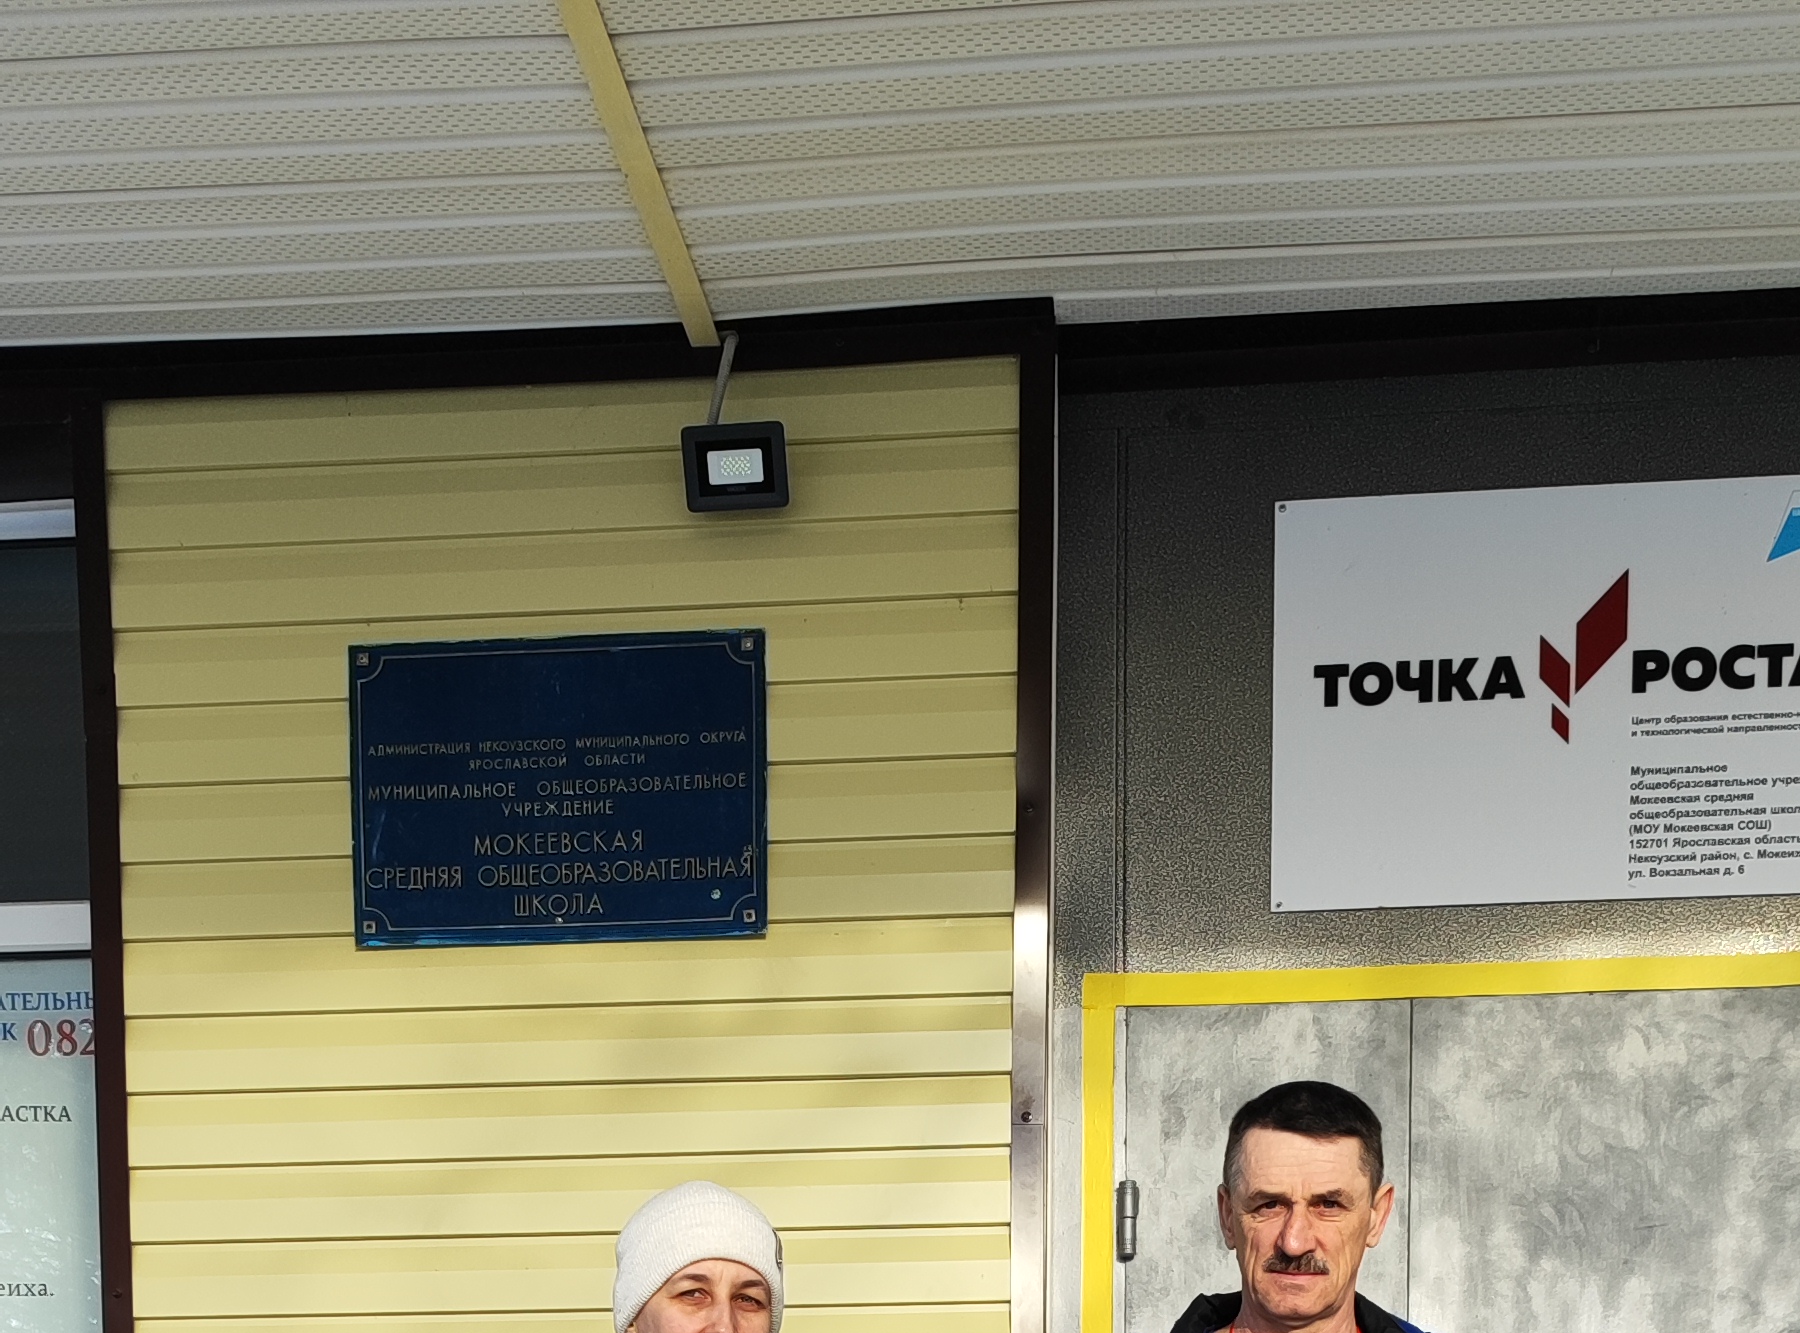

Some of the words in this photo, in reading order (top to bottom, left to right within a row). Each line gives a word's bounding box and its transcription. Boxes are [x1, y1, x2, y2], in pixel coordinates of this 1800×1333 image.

[1313, 655, 1526, 708] ТОЧКА
[1631, 643, 1800, 694] РОСТ
[1631, 716, 1662, 727] Центр
[1664, 713, 1729, 725] образования
[1640, 724, 1725, 737] технологической
[368, 742, 471, 757] АДМИНИСТРАЦИЯ
[478, 738, 567, 754] НЕКОУЗСКОГО
[576, 733, 690, 749] МУНИЦИПАЛЬНОГО
[700, 730, 747, 744] ОКРУГА
[469, 753, 567, 772] ЯРОСЛАВСКОЙ
[584, 753, 646, 767] ОБЛАСТИ
[1630, 764, 1729, 779] Муниципальное
[368, 782, 517, 801] МУНИЦИПАЛЬНОЕ
[537, 772, 748, 796] ОБЩЕОБРАЗОВАТЕЛЬНОЕ
[1630, 777, 1768, 792] общеобразовательное
[1630, 794, 1701, 806] Мокеевская
[1704, 792, 1754, 804] средняя
[501, 799, 614, 818] УЧРЕЖДЕНИЕ
[1629, 806, 1767, 820] общеобразовательная
[1629, 824, 1660, 837] (МОУ
[1663, 822, 1734, 834] Мокеевская
[1738, 820, 1772, 832] СОШ)
[474, 830, 644, 857] МОКЕЕВСКАЯ
[1629, 838, 1668, 849] 152701
[1672, 837, 1751, 848] Ярославская
[1628, 851, 1697, 865] Некоузский
[1700, 850, 1740, 864] район,
[1743, 851, 1754, 860] с.
[366, 866, 463, 891] СРЕДНЯЯ
[477, 854, 752, 888] ОБЩЕОБРАЗОВАТЕЛЬНАЯ
[1628, 869, 1646, 881] ул.
[1649, 865, 1720, 878] Вокзальная
[1723, 867, 1735, 877] д.
[1738, 864, 1745, 875] 6
[514, 893, 604, 917] ШКОЛА
